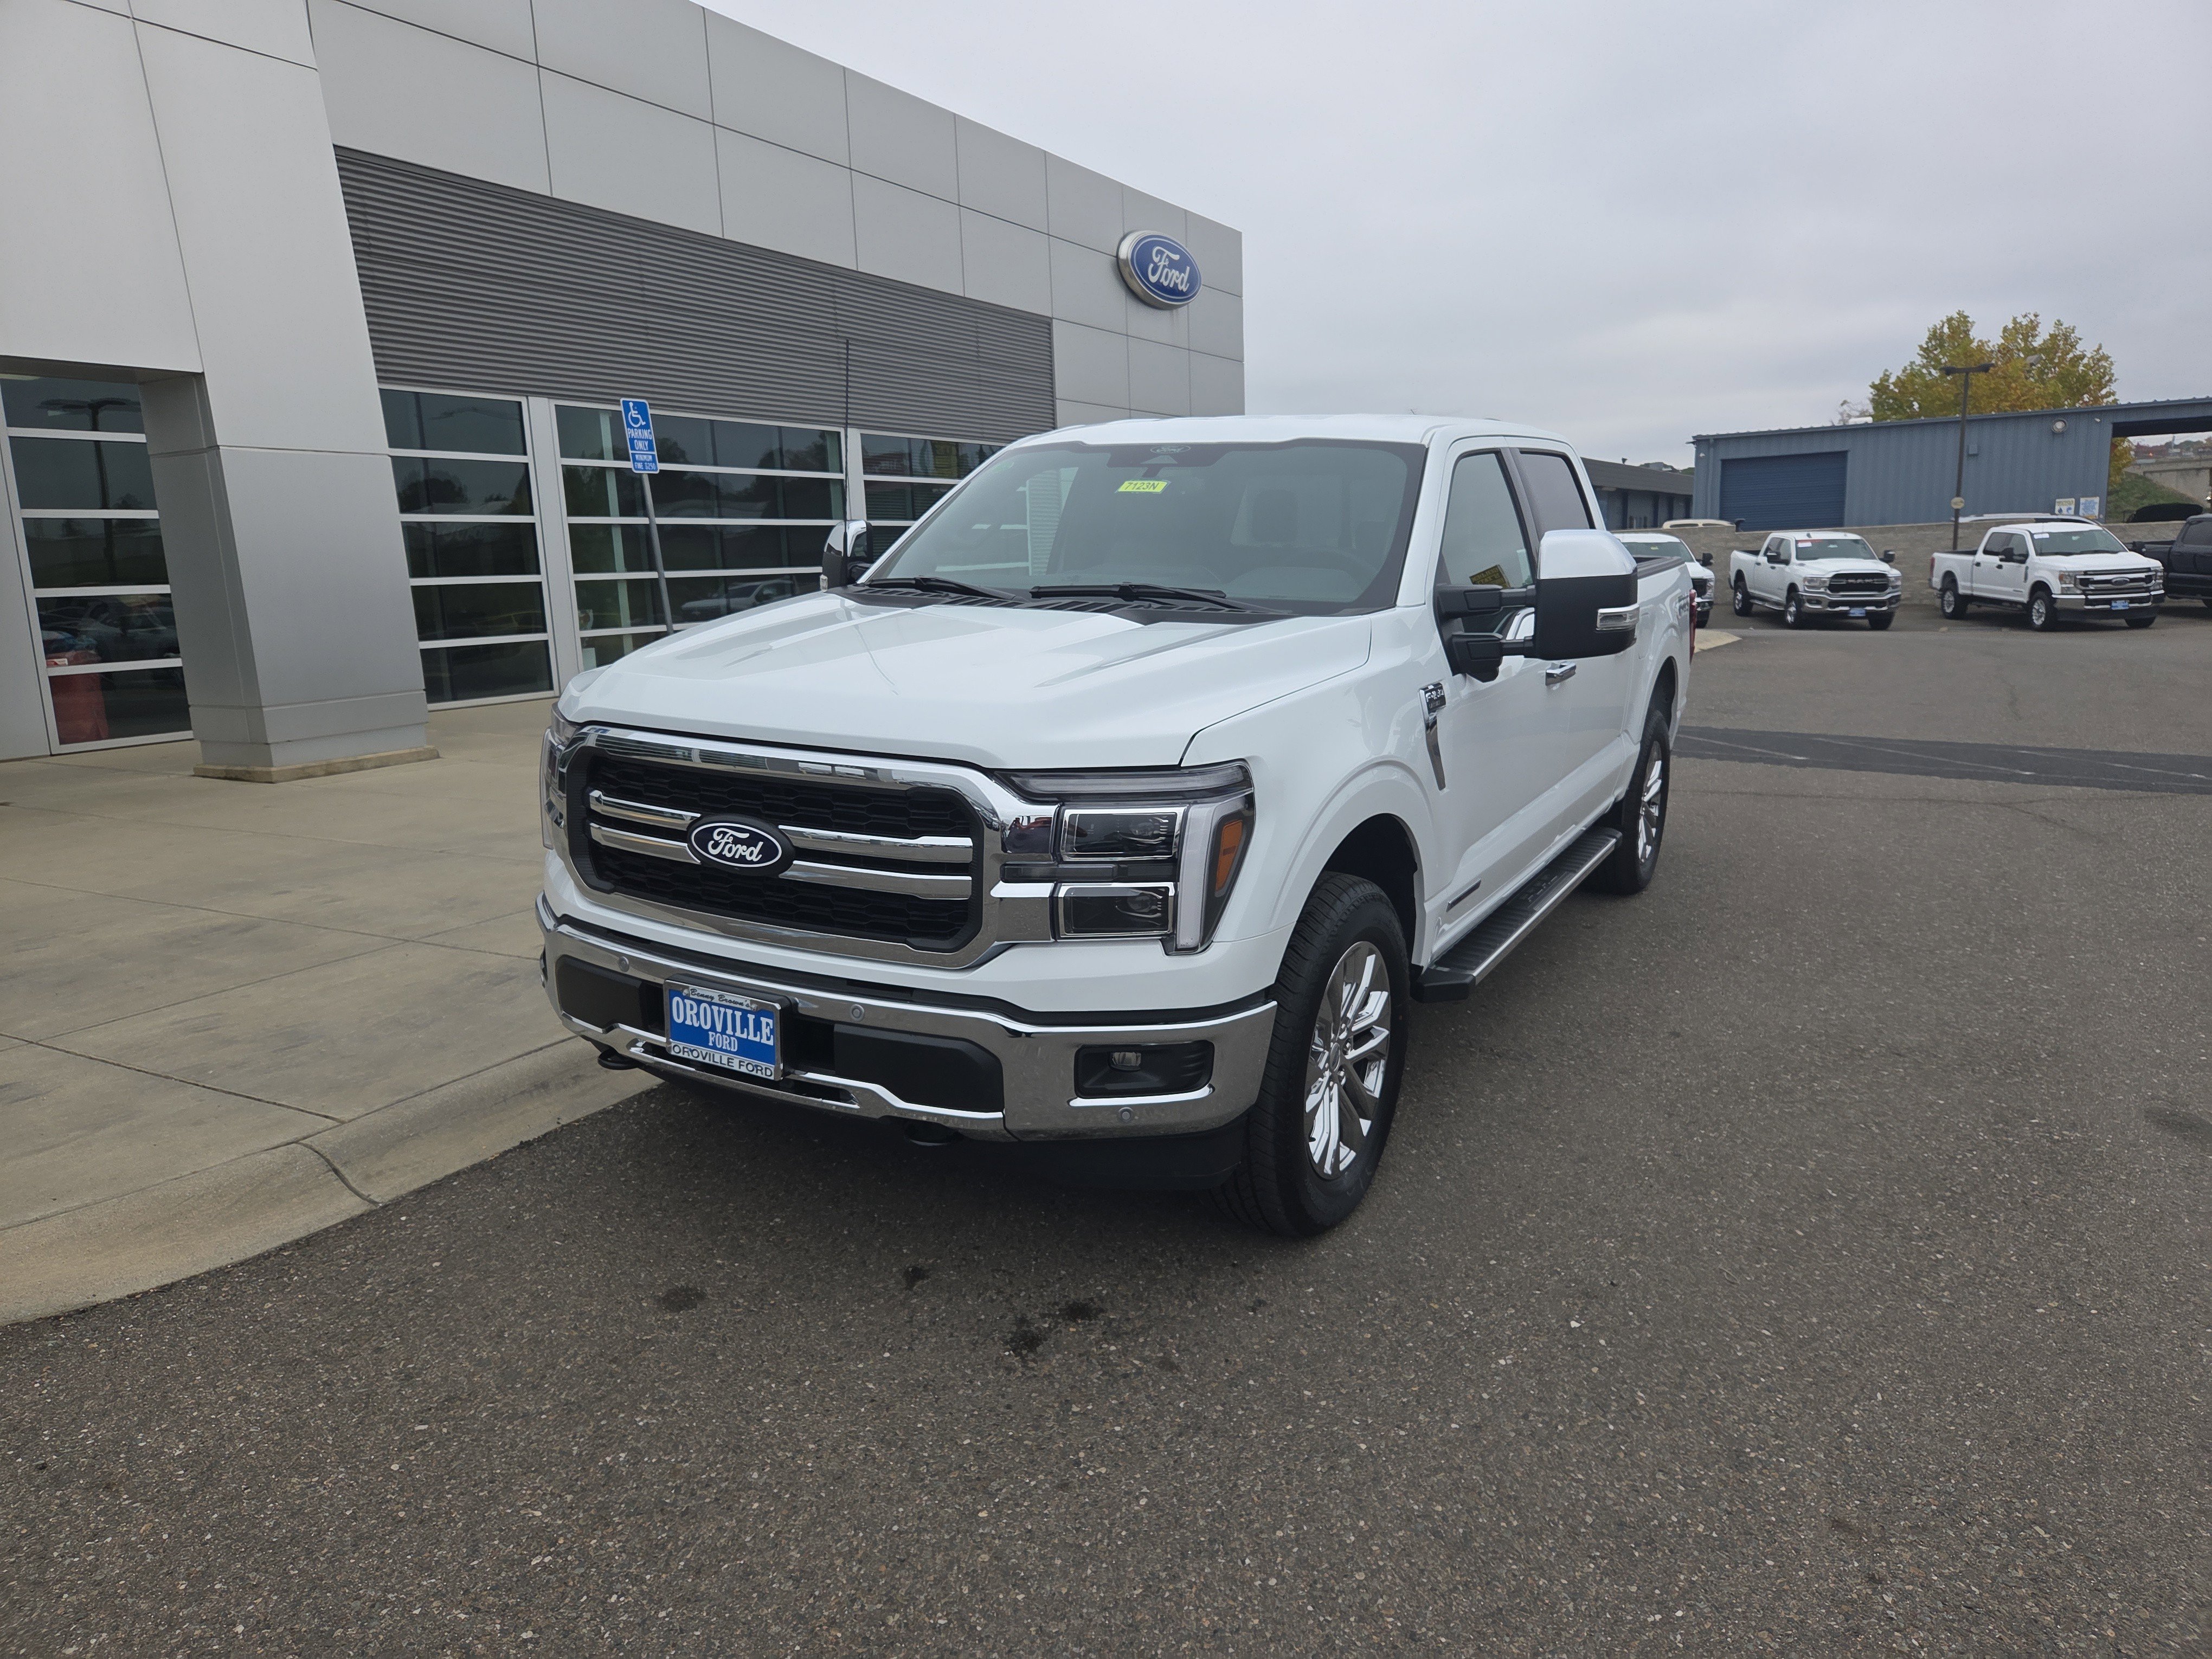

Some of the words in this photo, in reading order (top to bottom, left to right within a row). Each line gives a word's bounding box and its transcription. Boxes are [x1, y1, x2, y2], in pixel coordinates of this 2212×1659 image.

[1148, 246, 1189, 292] Ford
[627, 428, 652, 440] PARKING
[634, 440, 648, 450] ONLY
[1124, 482, 1160, 490] 7123N
[708, 828, 763, 861] Ford
[690, 988, 715, 1001] Benny
[718, 994, 750, 1008] Brown's
[672, 996, 774, 1046] OROVILLE
[709, 1032, 738, 1052] FORD
[672, 1044, 735, 1068] OROVILLE
[738, 1059, 773, 1077] FORD
